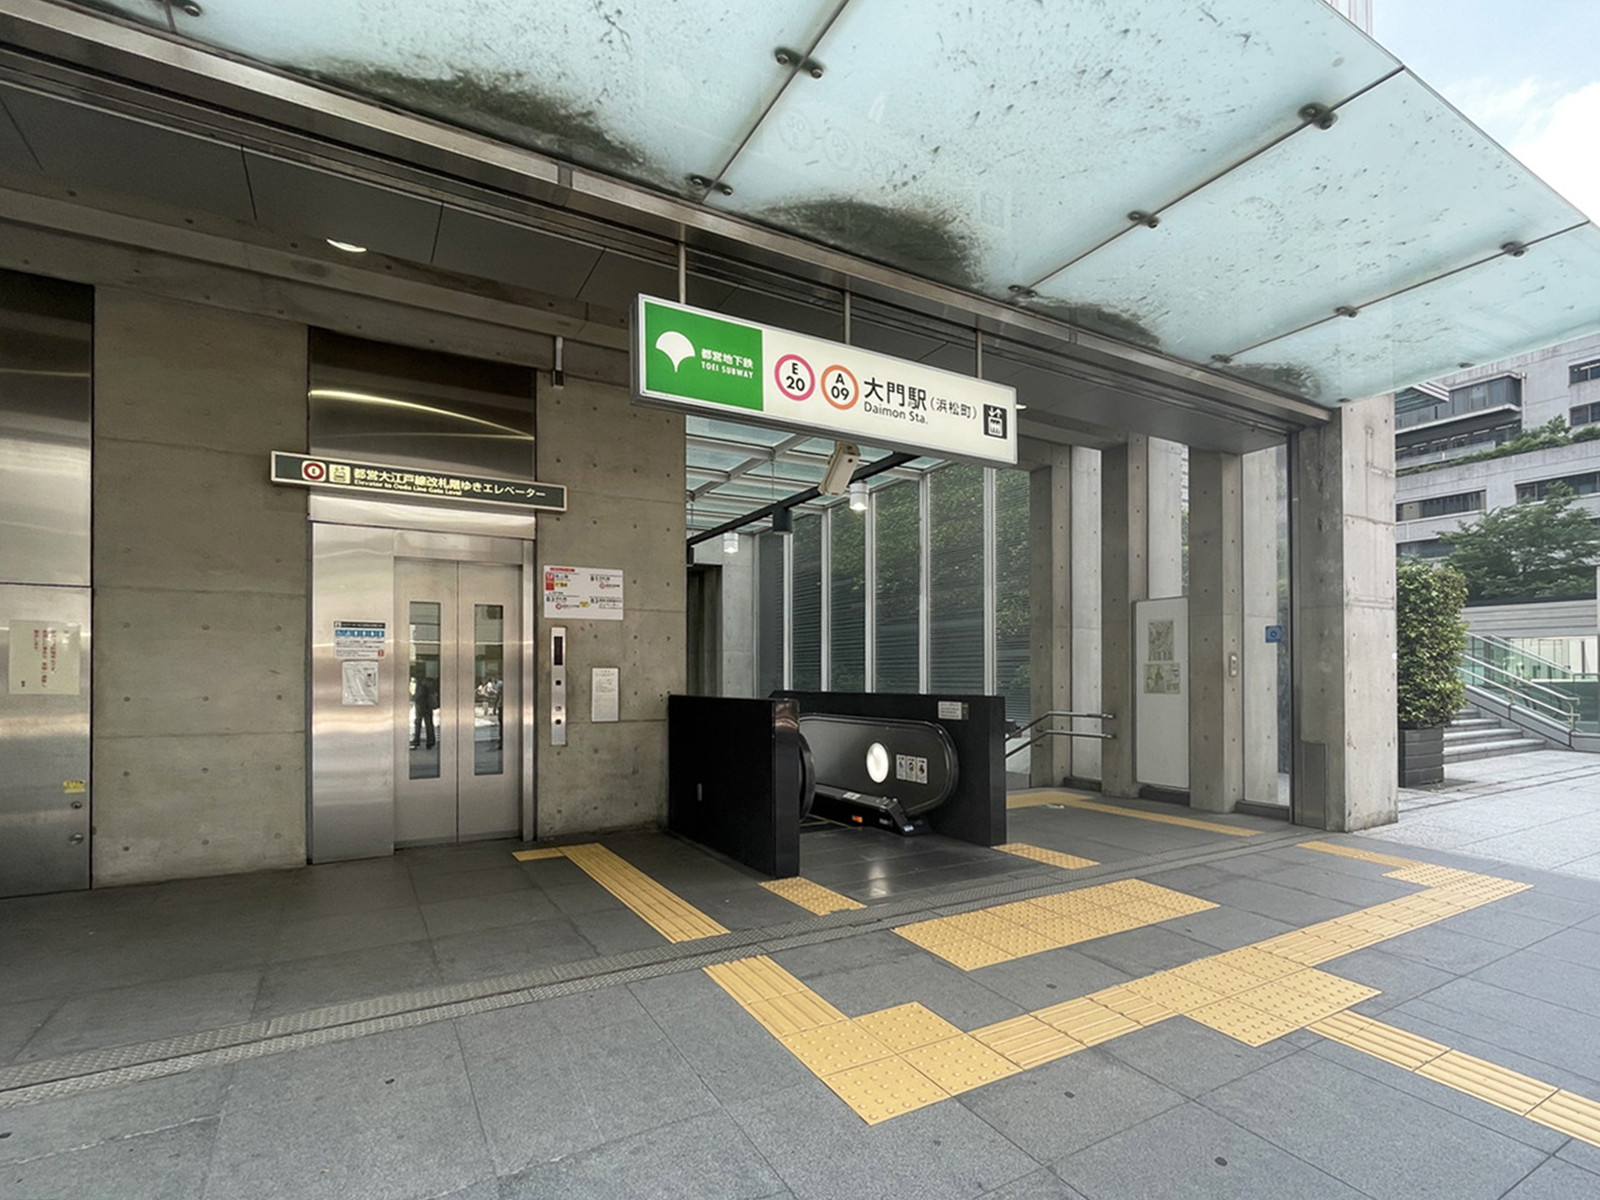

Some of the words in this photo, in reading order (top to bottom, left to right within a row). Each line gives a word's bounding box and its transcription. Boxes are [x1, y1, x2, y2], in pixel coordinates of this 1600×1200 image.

[701, 348, 754, 369] 都営地下鉄
[701, 361, 719, 372] TOEI
[721, 365, 754, 379] SUBWAY
[792, 362, 799, 375] E
[786, 375, 805, 391] 20
[835, 373, 845, 385] A
[831, 385, 849, 400] 09
[864, 401, 906, 419] Daimon
[909, 411, 928, 424] Sta.
[354, 479, 382, 488] Elevator
